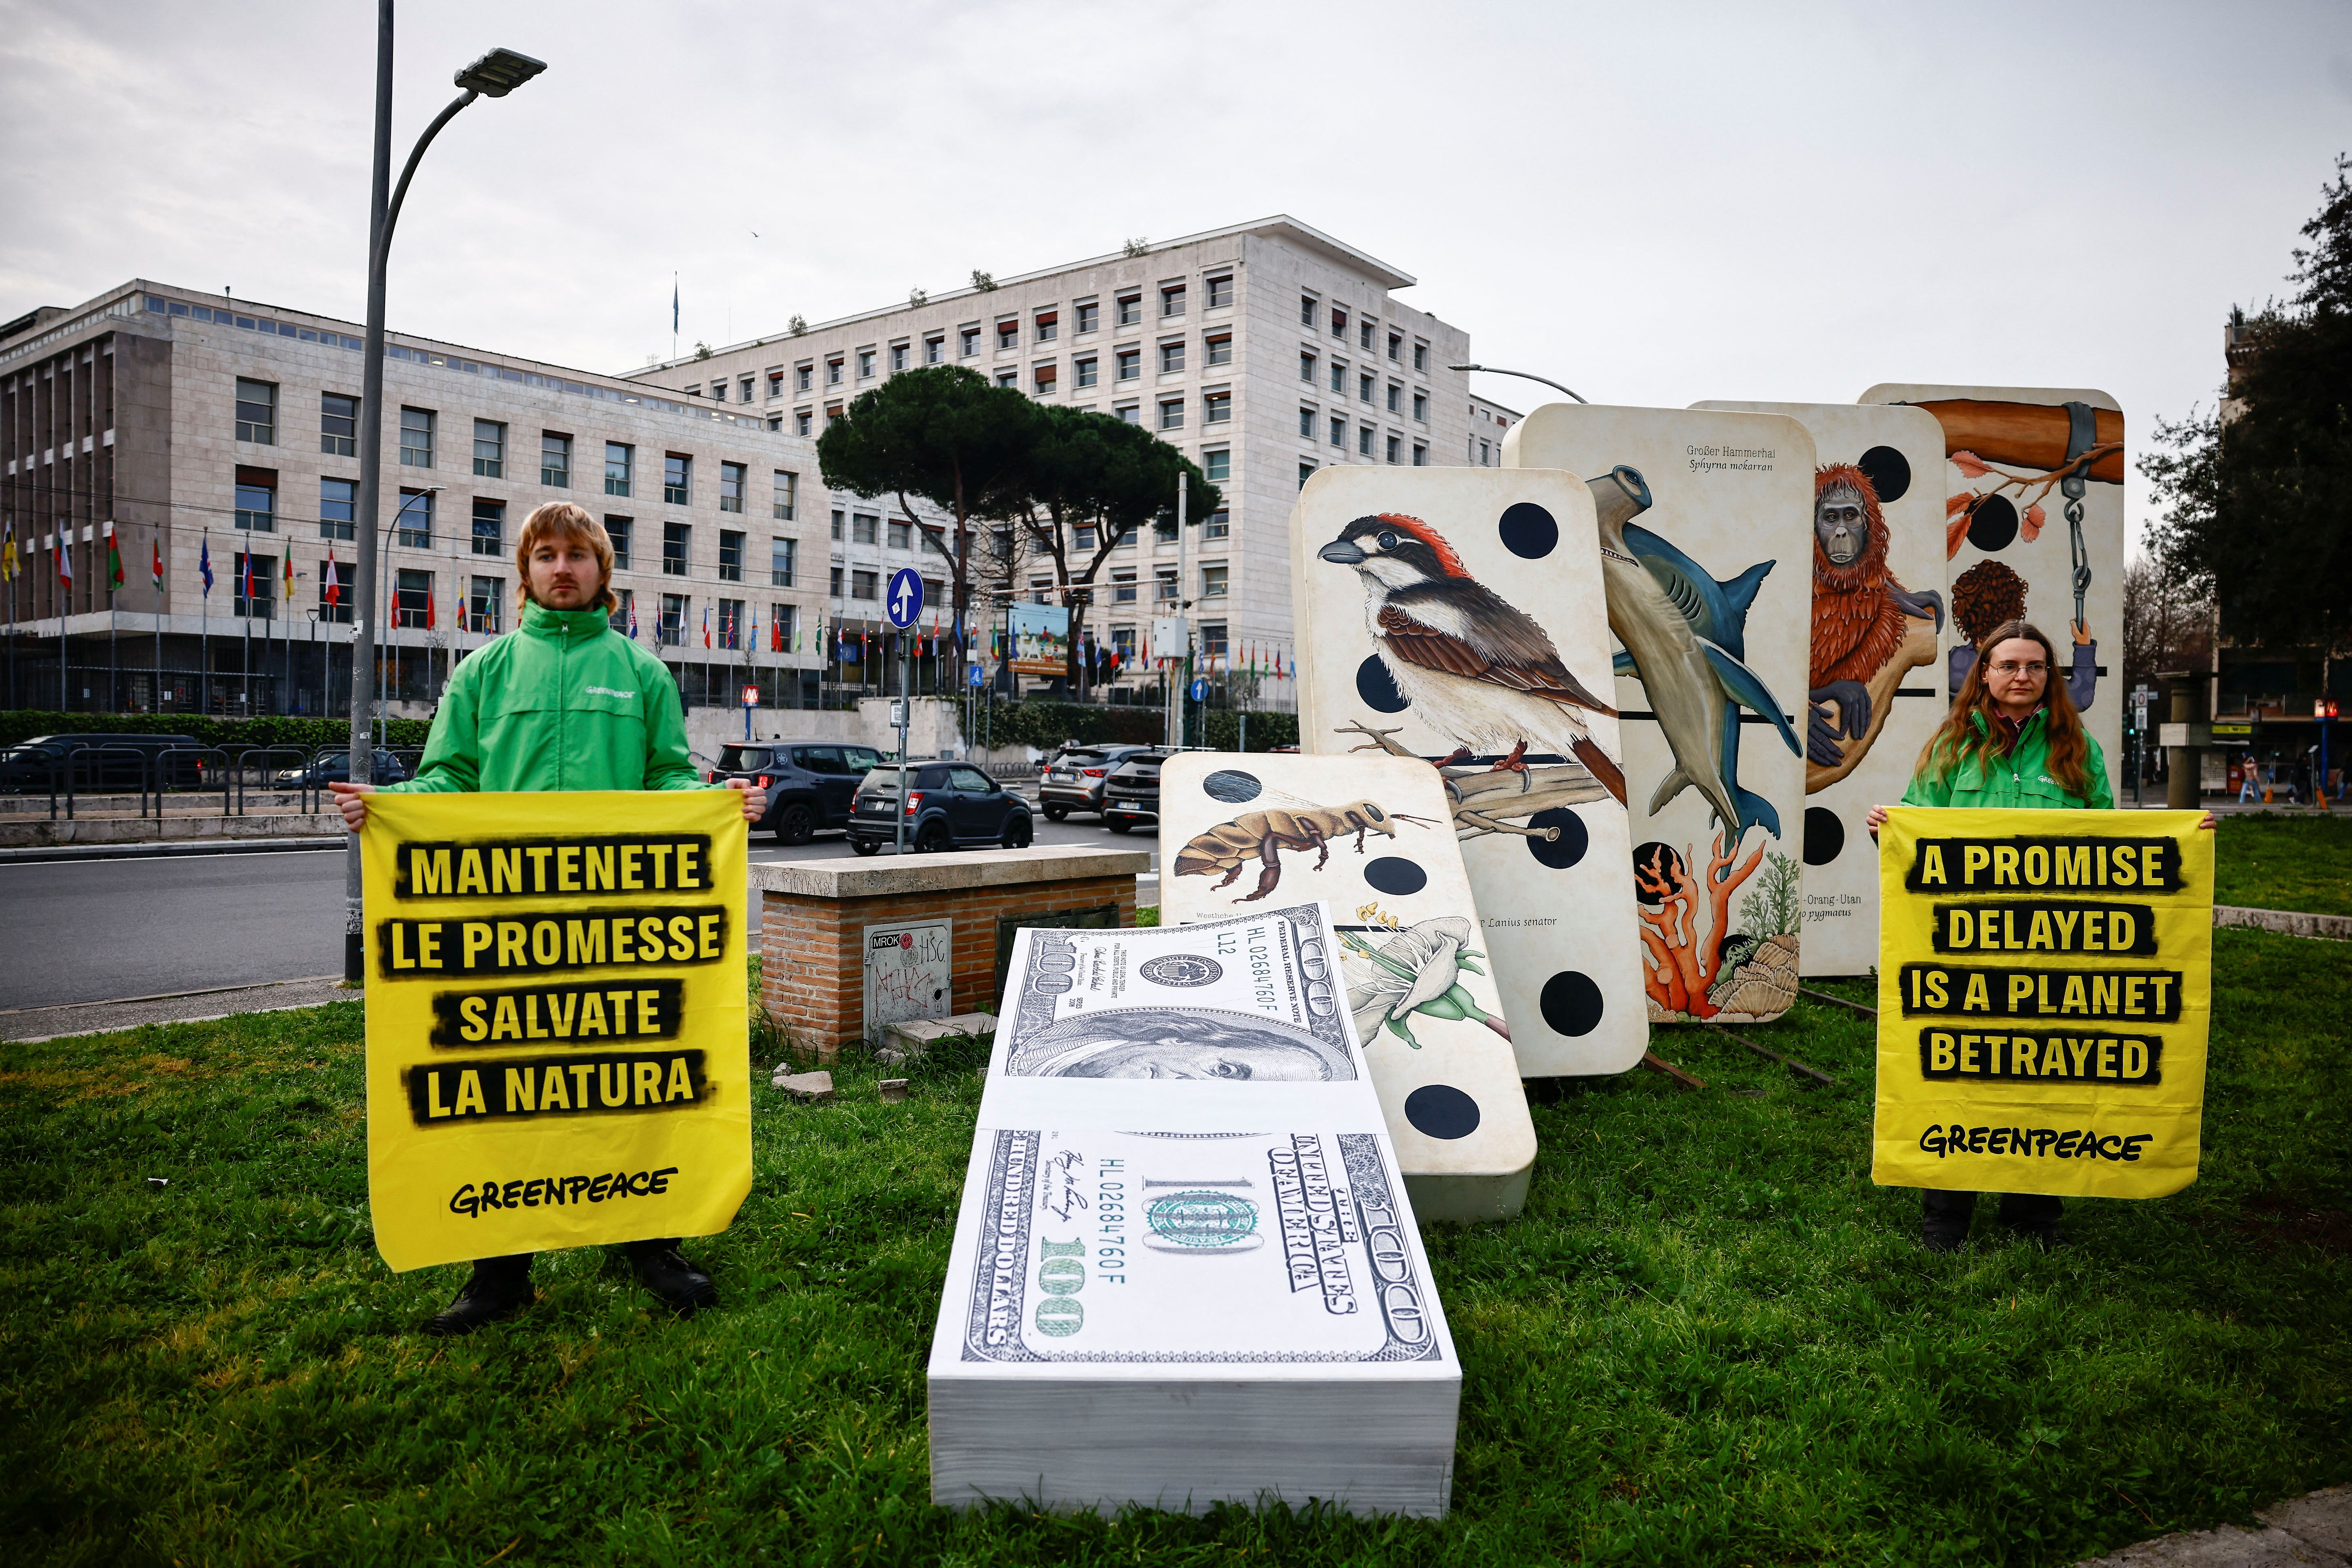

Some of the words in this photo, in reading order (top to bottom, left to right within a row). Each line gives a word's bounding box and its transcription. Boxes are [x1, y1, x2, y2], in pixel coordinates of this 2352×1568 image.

[1687, 445, 1720, 456] Großer
[1723, 446, 1775, 458] Hammerhai
[1689, 458, 1727, 473] Sphyrna
[1730, 459, 1773, 471] mokarran
[411, 843, 700, 894] MANTENETE
[1921, 845, 1947, 884] A
[1964, 845, 2165, 886] PROMISE
[1488, 918, 1520, 927] Lanius
[1524, 918, 1557, 926] senator
[1807, 910, 1851, 922] pygmaeus
[1948, 909, 2135, 951] DELAYED
[391, 920, 443, 970] LE
[462, 914, 721, 969] PROMESSE
[873, 935, 899, 948] MROK
[1153, 956, 1189, 964] FEDERAL
[1217, 932, 1236, 955] L12
[1156, 978, 1192, 986] SYSTEM
[1278, 920, 1290, 961] FEDERAL
[1284, 962, 1297, 1001] RESERVE
[1291, 1002, 1302, 1023] NOTE
[1296, 918, 1336, 1017] 100
[1911, 969, 1949, 1009] IS
[1962, 974, 1990, 1012] A
[2007, 974, 2173, 1015] PLANET
[459, 990, 661, 1042] SALVATE
[1010, 1053, 1021, 1076] FRANKLI
[1930, 1033, 2148, 1079] BETRAYED
[427, 1069, 486, 1118] LA
[505, 1057, 693, 1112] NATURA
[1268, 1146, 1299, 1177] OF
[1918, 1124, 2154, 1162] GREENPEACE
[449, 1167, 678, 1218] GREENPEACE
[999, 1138, 1029, 1235] HUNDRED
[1272, 1172, 1320, 1293] AMERICA
[1331, 1188, 1359, 1243] THE
[1035, 1236, 1086, 1337] 100
[1308, 1214, 1358, 1315] STATES
[1356, 1199, 1428, 1345] 100
[986, 1234, 1016, 1345] DOLLARS
